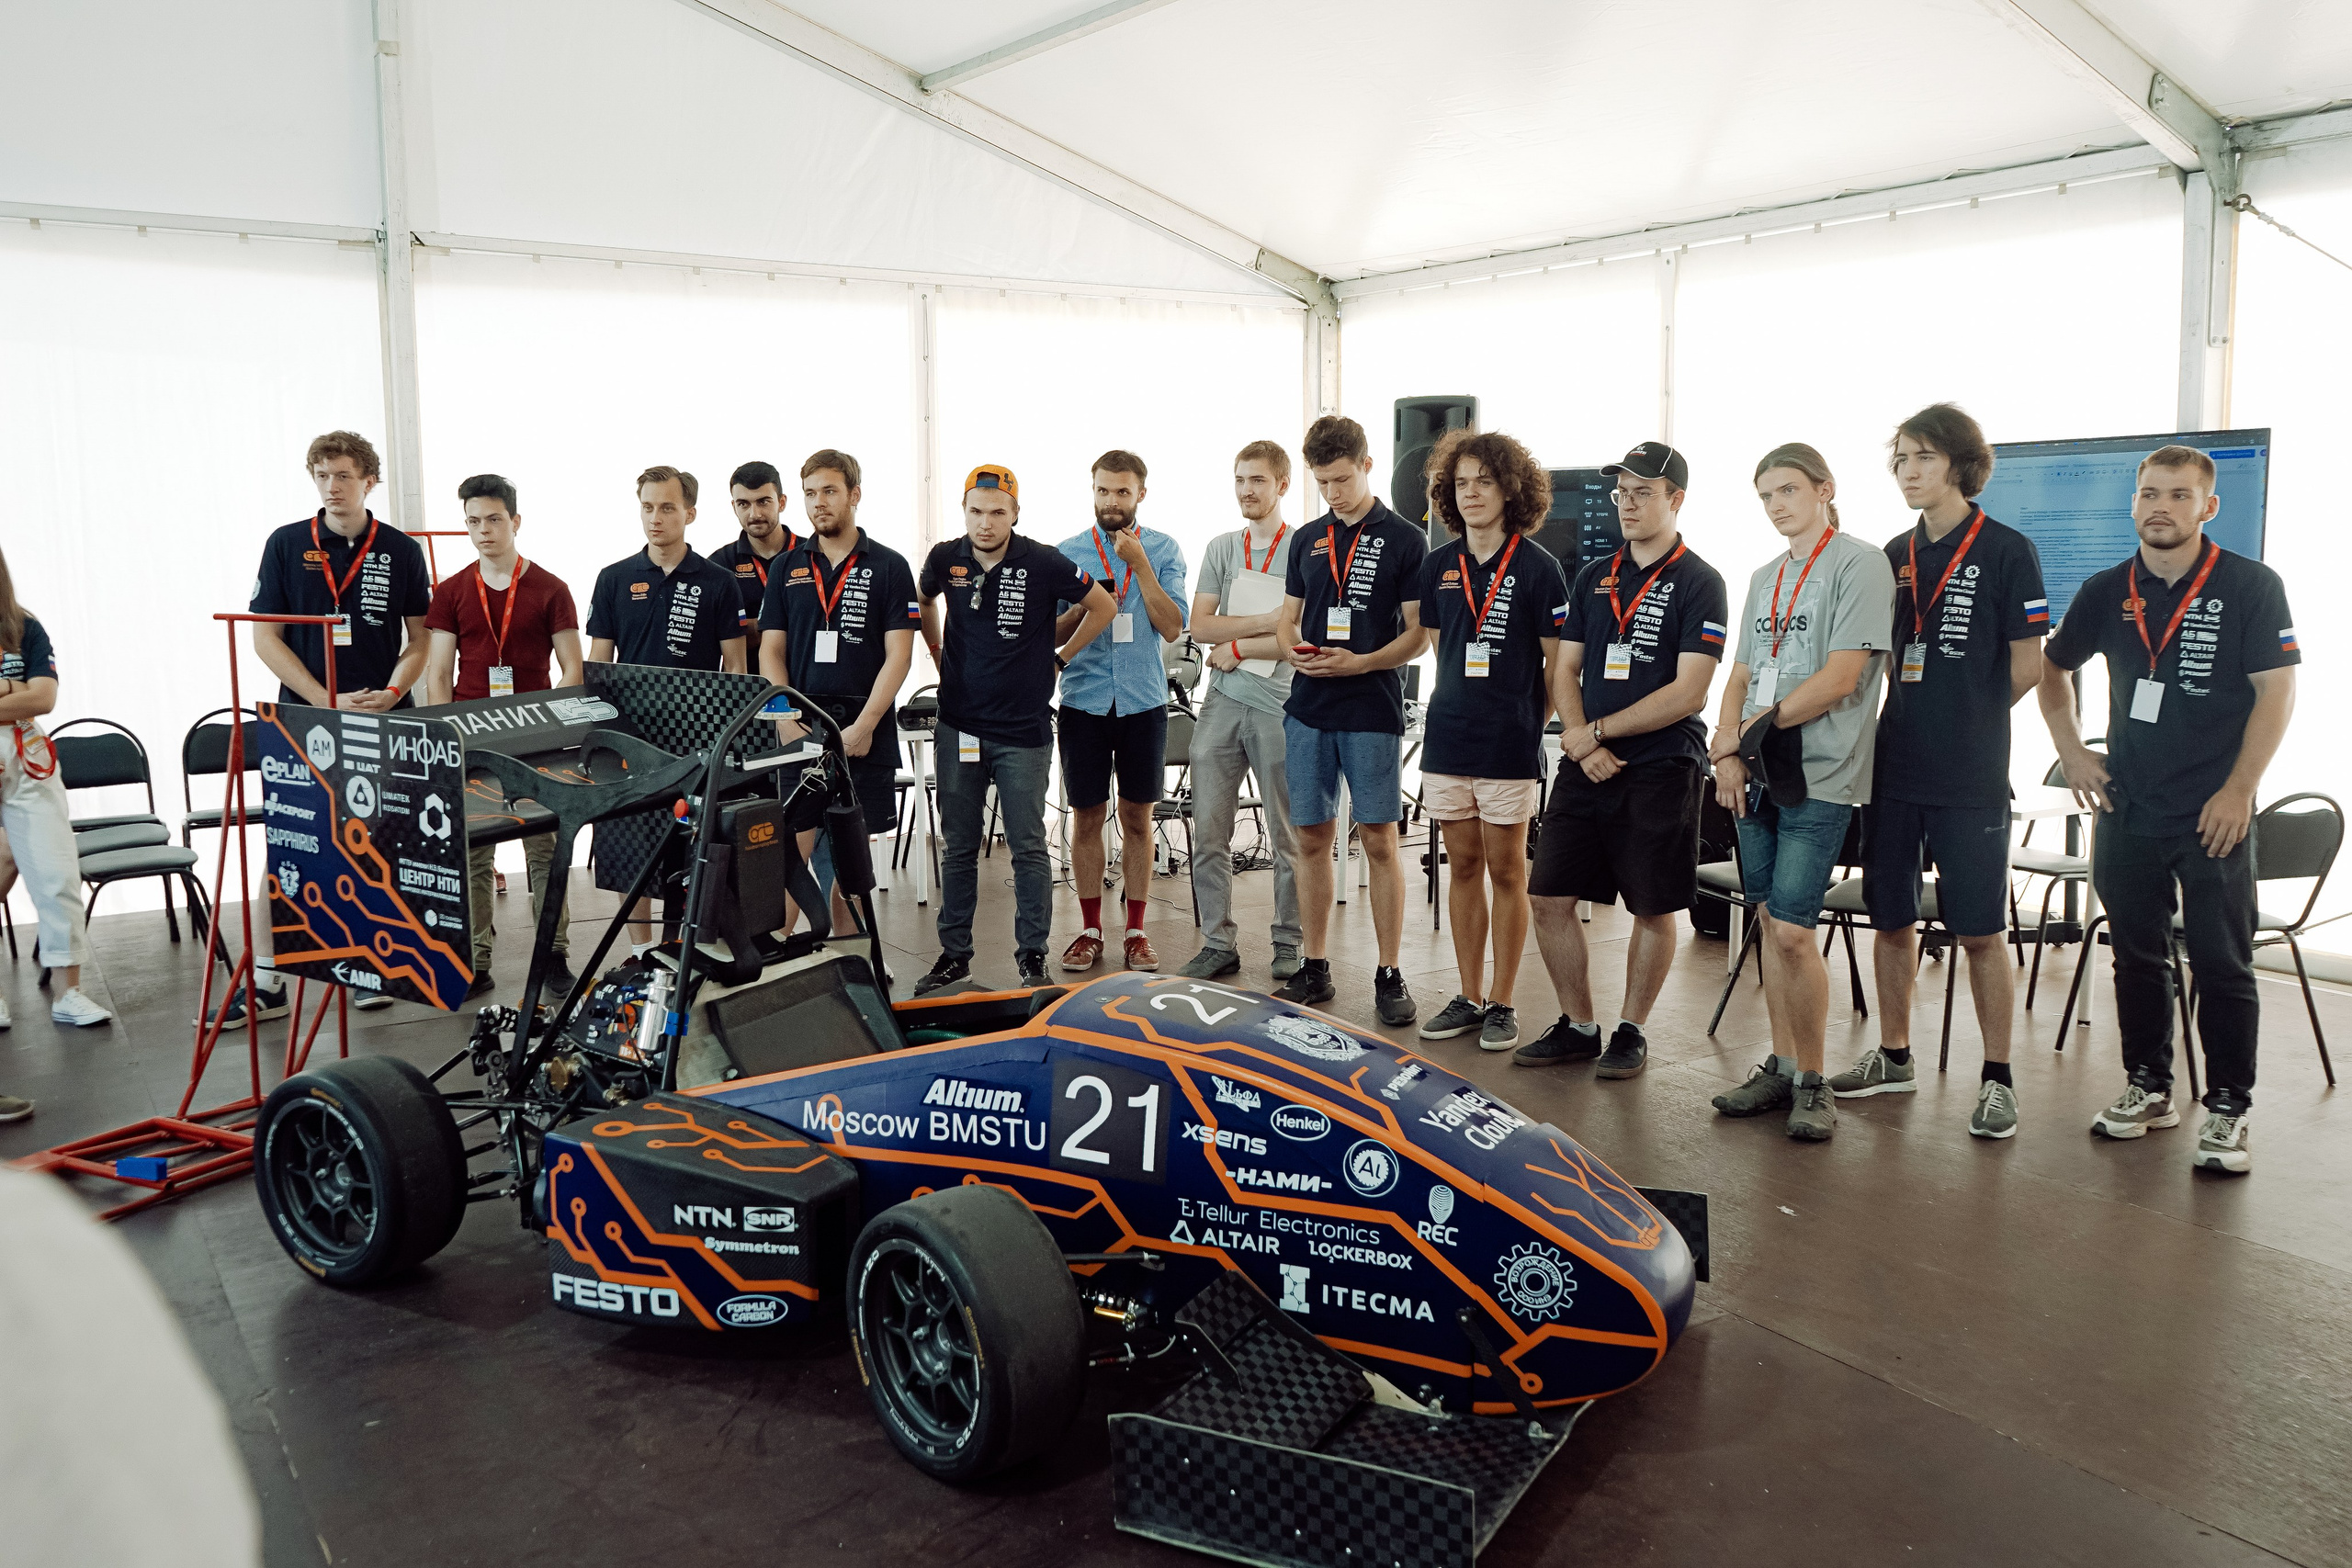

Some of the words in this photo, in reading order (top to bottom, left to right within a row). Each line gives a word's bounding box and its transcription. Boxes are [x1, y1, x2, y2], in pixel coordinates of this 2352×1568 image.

[1350, 568, 1375, 576] FESTO
[361, 583, 390, 592] FESTO
[669, 615, 695, 625] FESTO
[1487, 610, 1509, 619] ESTO
[1634, 615, 1662, 625] FESTO
[1641, 624, 1660, 632] ALTAIR
[2180, 642, 2216, 651] FESTO
[388, 734, 461, 768] ИНФАБ
[266, 827, 319, 853] SAPPHIRUS
[399, 867, 435, 887] ЦЕНТР
[437, 875, 460, 894] НТИ
[350, 969, 381, 990] AMR
[1060, 1075, 1159, 1172] 21
[1276, 1113, 1325, 1132] Henkel
[1419, 1090, 1491, 1133] Yandex
[802, 1100, 920, 1138] Moscow
[930, 1111, 1046, 1150] BMSTU
[1182, 1122, 1267, 1156] xsens
[1197, 1201, 1250, 1225] Tellur
[1260, 1210, 1380, 1245] Electronics
[1418, 1220, 1459, 1247] REC
[705, 1236, 800, 1256] Symmetron
[1202, 1228, 1280, 1255] ALTAIR
[1510, 1258, 1560, 1286] ВОЗРОЖДЕНИЕ
[552, 1272, 680, 1317] FESTO
[727, 1301, 776, 1314] FORMULA
[1322, 1284, 1435, 1323] ITECMA
[731, 1312, 775, 1323] CARBON
